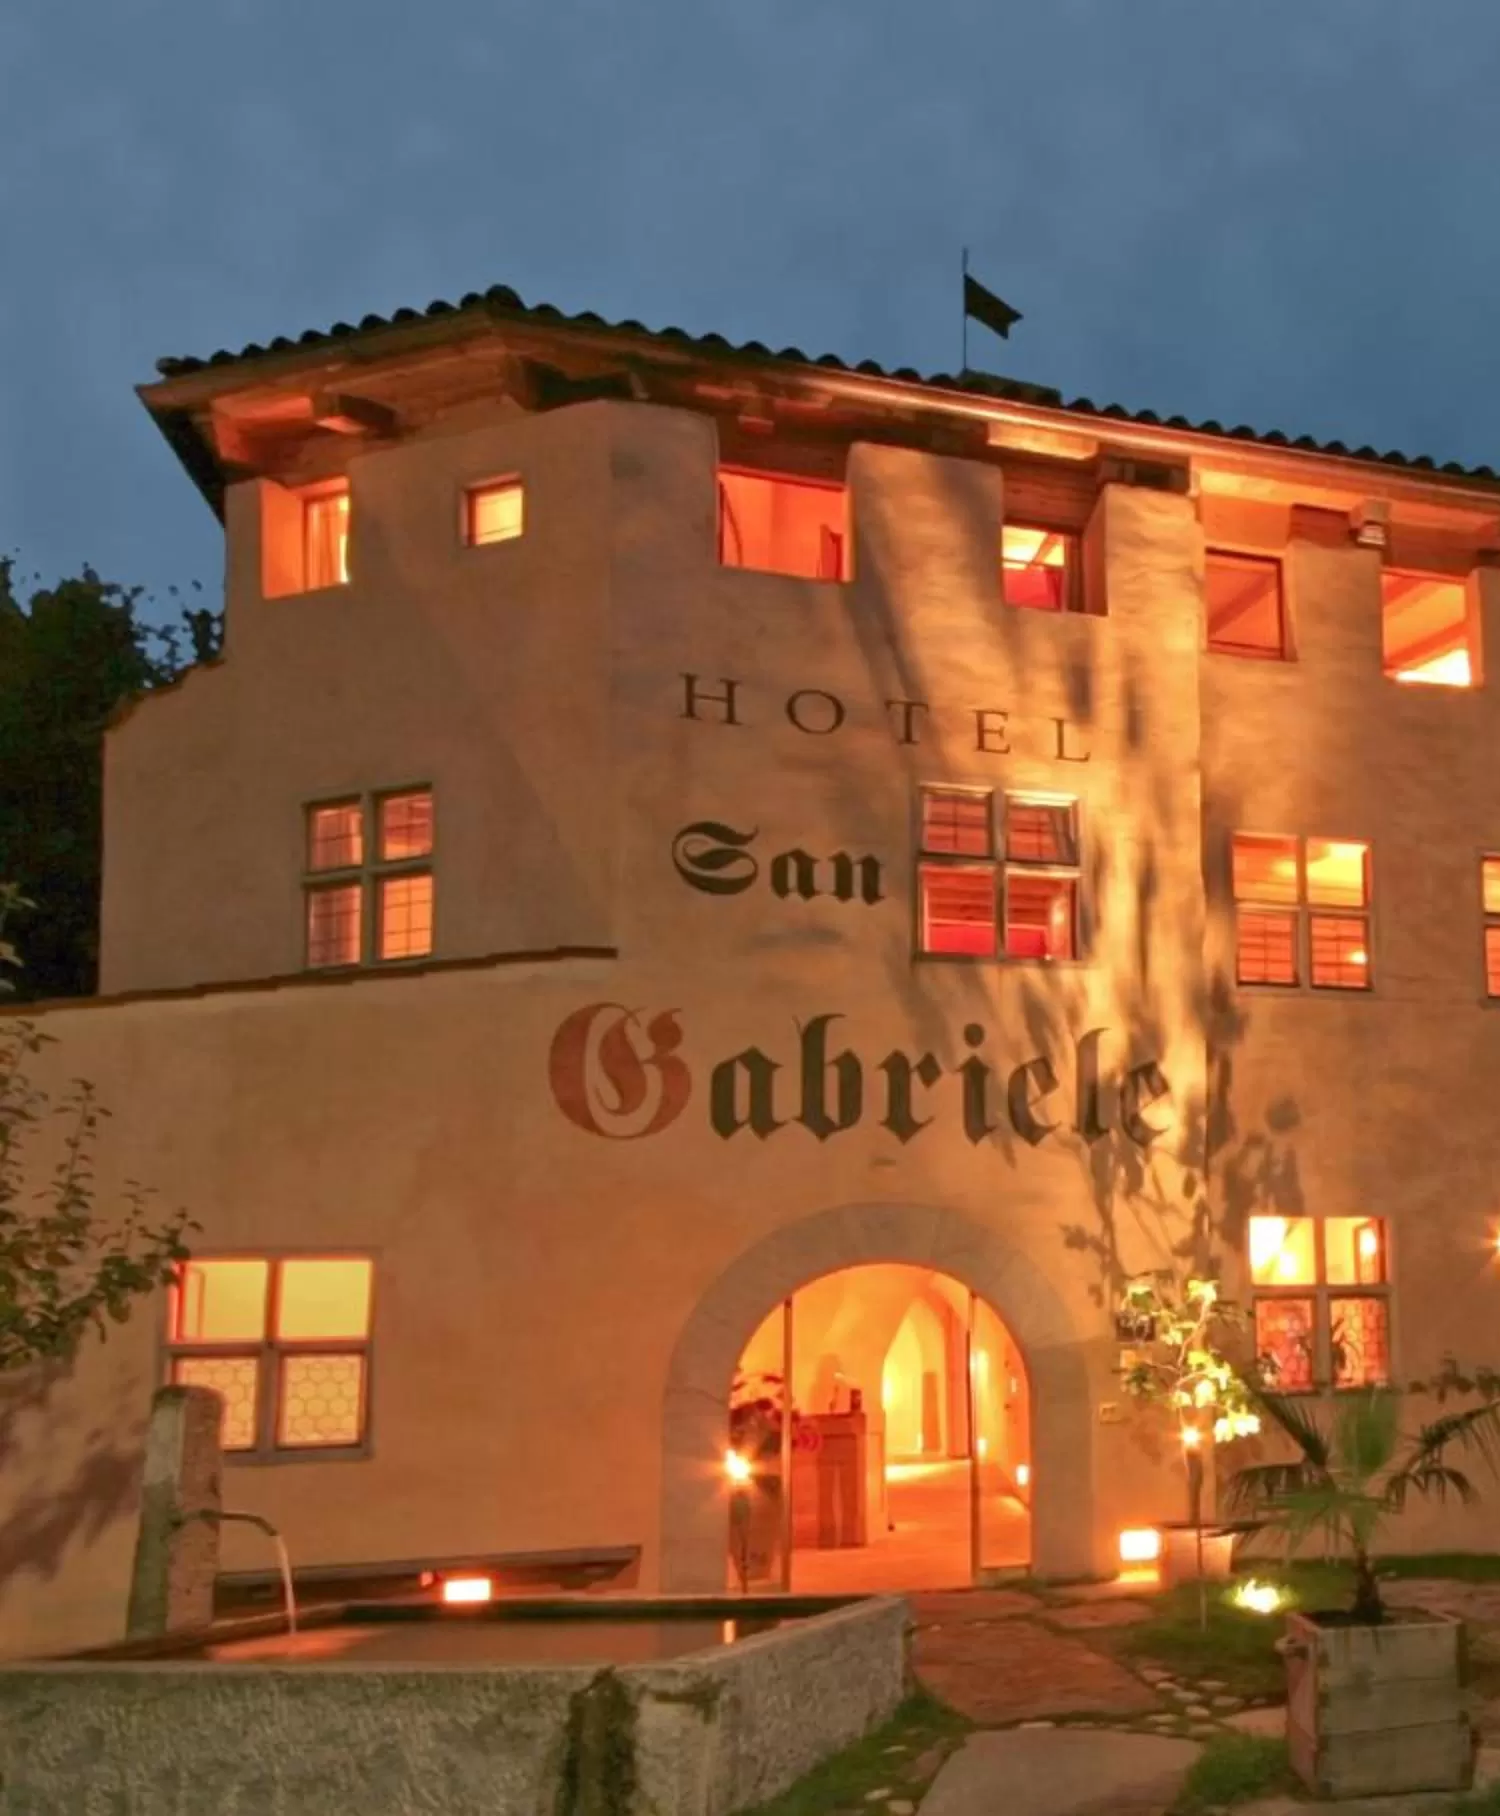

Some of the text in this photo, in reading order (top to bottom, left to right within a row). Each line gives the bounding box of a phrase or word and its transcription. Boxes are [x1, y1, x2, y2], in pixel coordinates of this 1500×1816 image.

[679, 672, 1091, 763] HOTEL
[671, 821, 885, 906] San
[548, 1003, 1171, 1147] Gabriele
